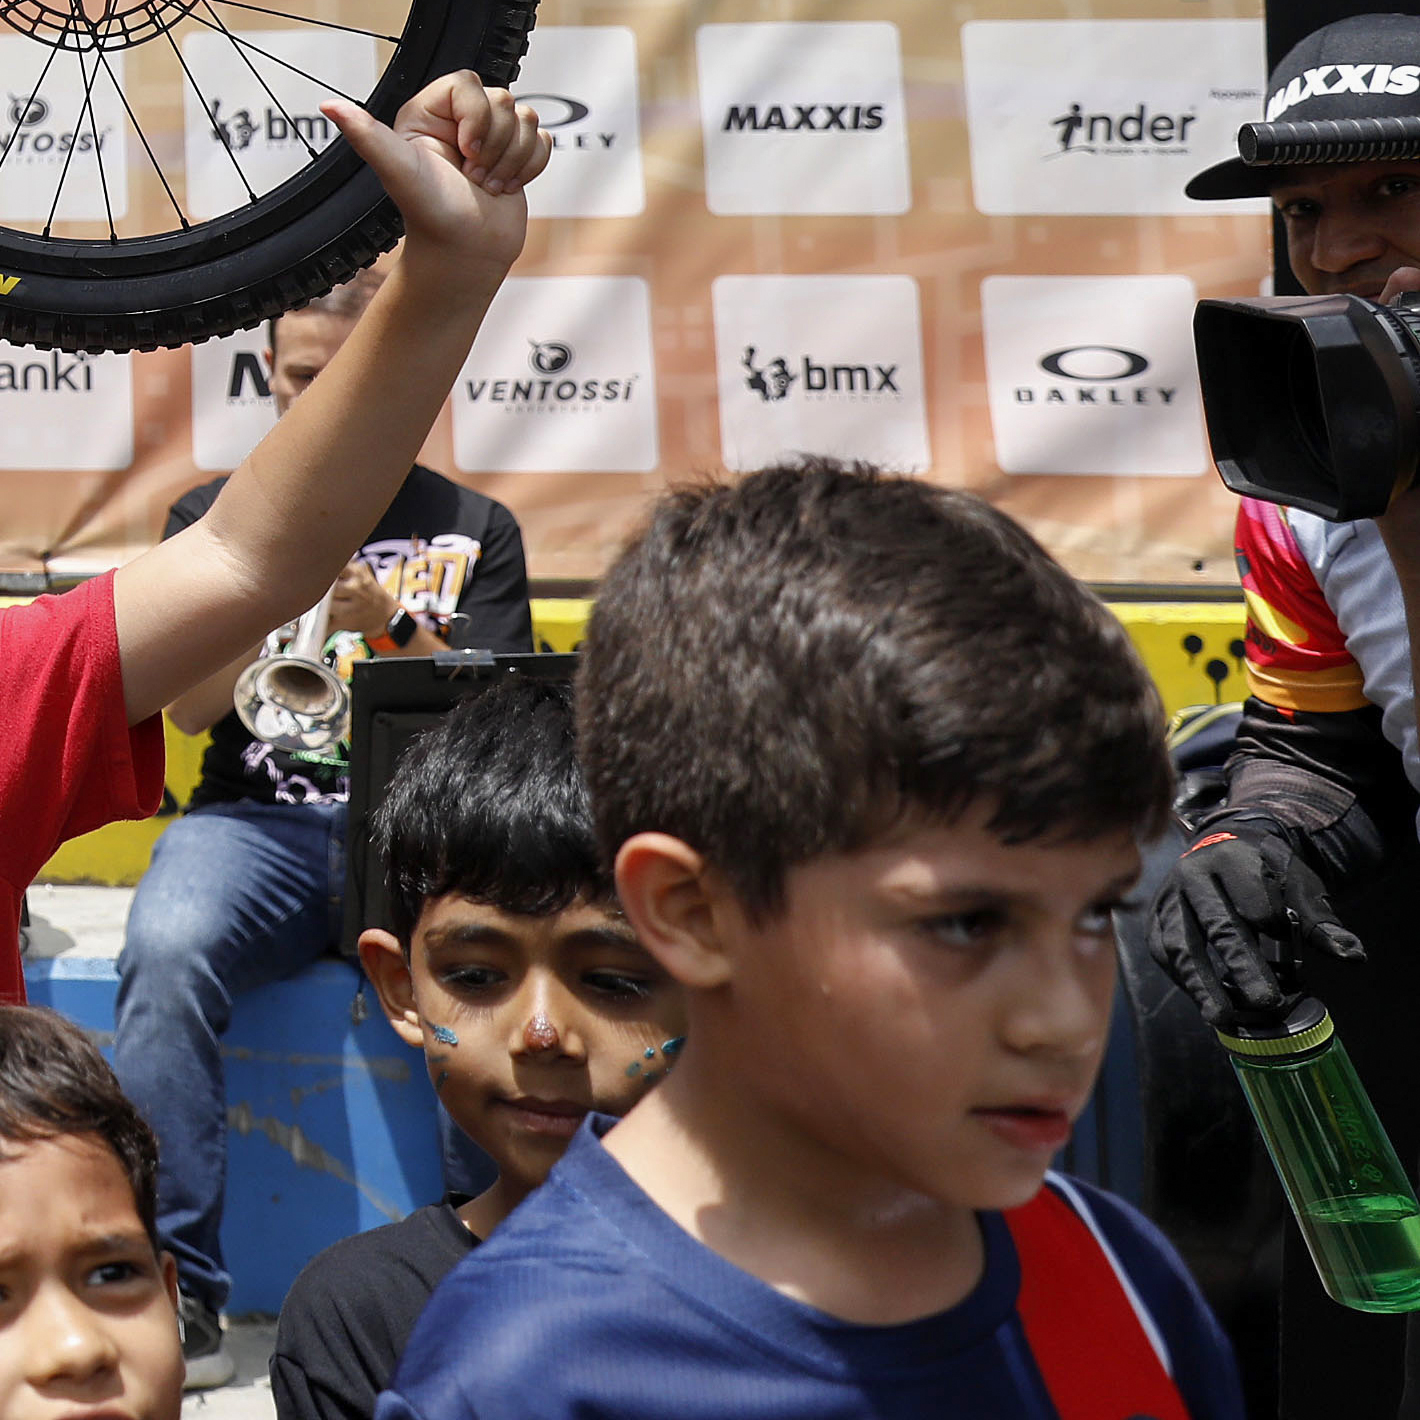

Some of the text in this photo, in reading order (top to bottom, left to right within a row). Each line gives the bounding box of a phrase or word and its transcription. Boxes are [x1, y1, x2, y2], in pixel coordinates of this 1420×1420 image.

[267, 107, 328, 139] bm
[724, 104, 883, 131] MAXXIS
[553, 131, 617, 150] LEY
[804, 357, 899, 392] bmx
[1014, 386, 1178, 404] OAKLEY
